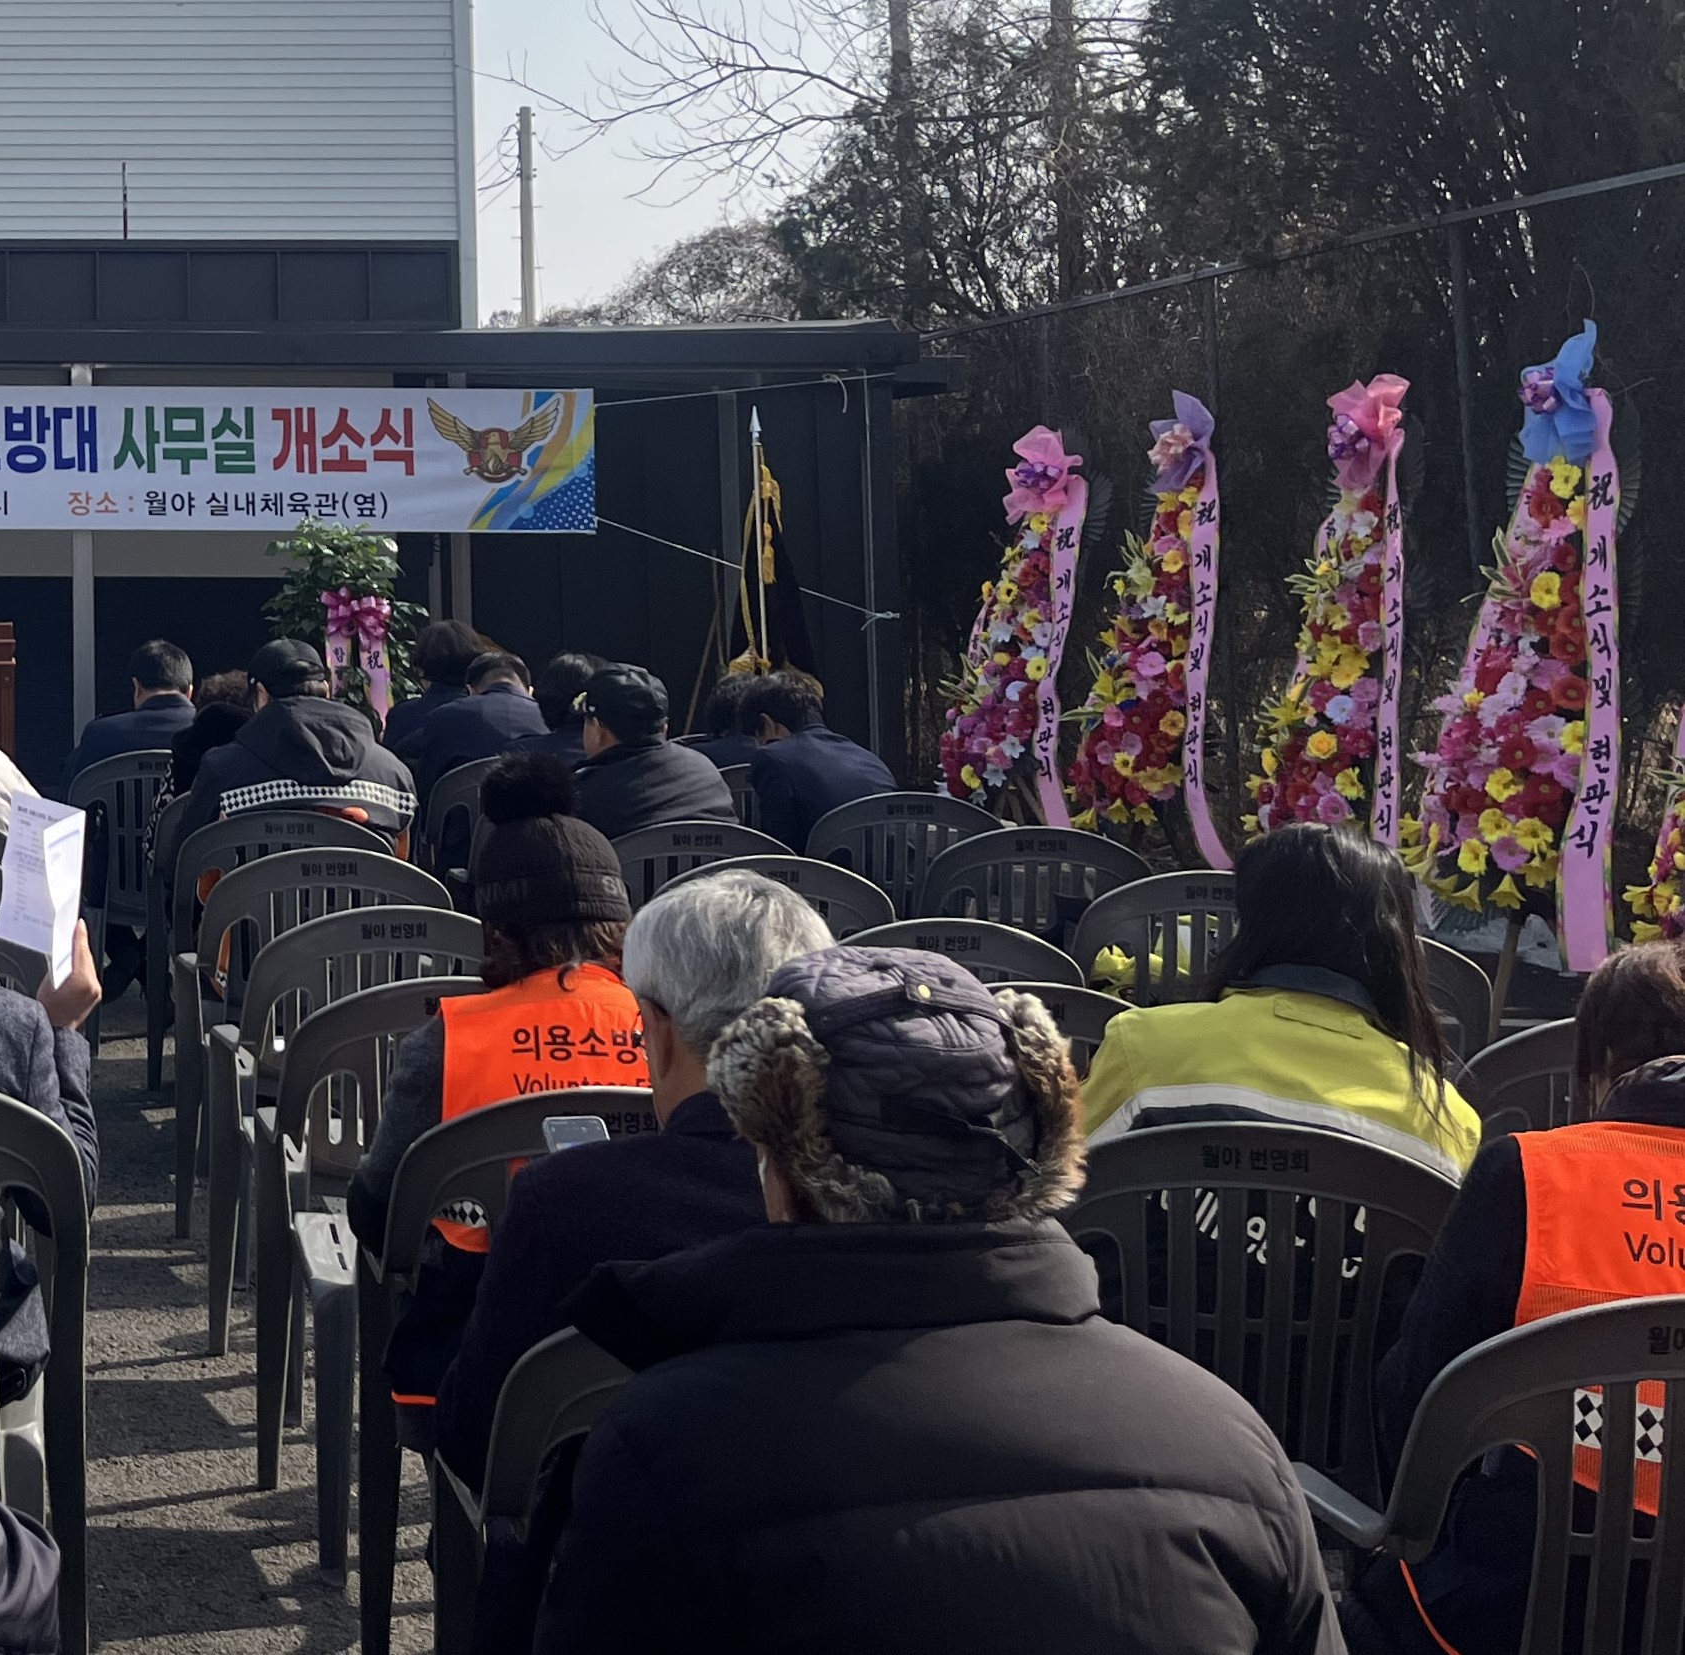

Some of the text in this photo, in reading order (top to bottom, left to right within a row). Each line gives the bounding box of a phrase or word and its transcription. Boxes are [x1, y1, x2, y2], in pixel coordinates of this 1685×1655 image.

[114, 405, 257, 475] 사무실
[271, 406, 415, 476] 개소식
[144, 491, 196, 517] 월야
[1589, 471, 1614, 511] 祝
